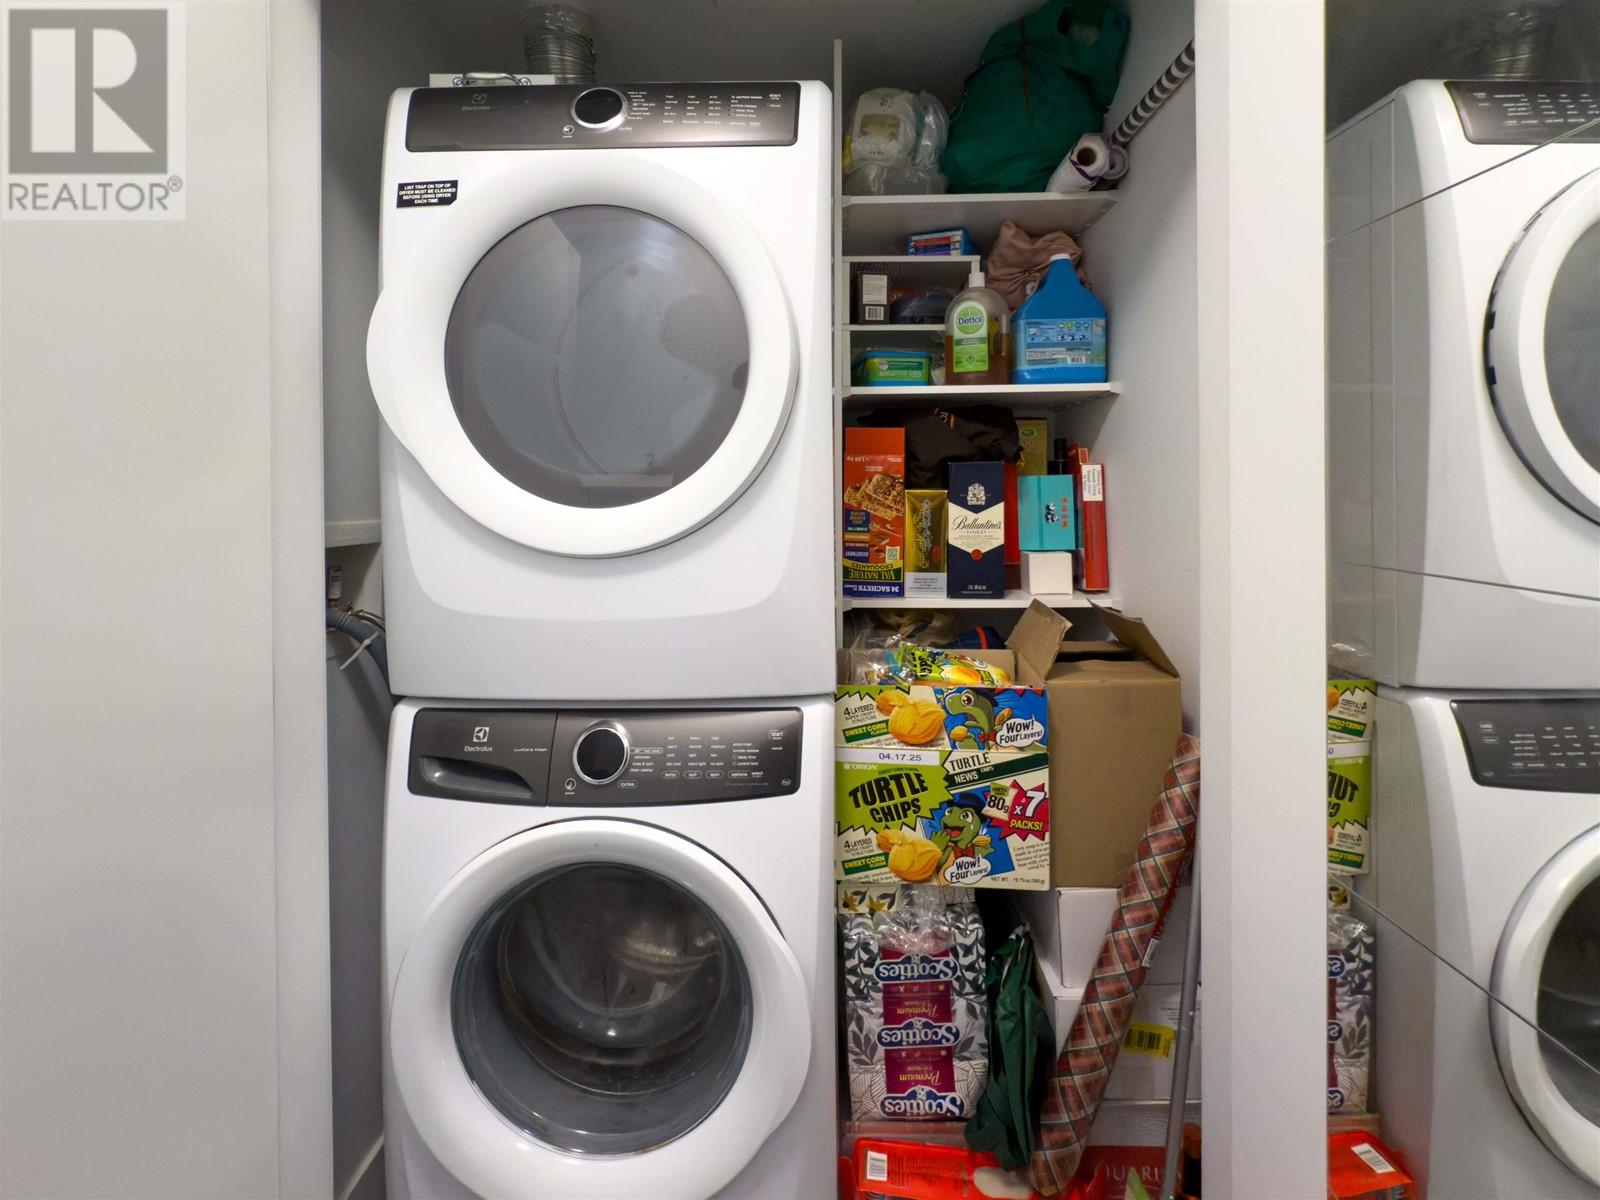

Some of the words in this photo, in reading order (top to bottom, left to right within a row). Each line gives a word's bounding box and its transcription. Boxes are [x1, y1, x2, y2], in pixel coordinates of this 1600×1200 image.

[959, 316, 982, 325] Dettol
[952, 515, 1002, 531] Ballantine's
[849, 569, 879, 580] NATURE
[881, 570, 896, 580] VAL
[843, 707, 851, 716] 4
[851, 703, 875, 715] LAYERED
[845, 726, 867, 736] SWEET
[867, 722, 887, 731] CORN
[1006, 720, 1035, 734] Wow!
[1000, 733, 1020, 744] Four
[1020, 729, 1043, 740] Layers!
[879, 752, 922, 762] 04.17.25
[949, 752, 991, 772] TURTLE
[954, 771, 979, 785] NEWS
[848, 772, 929, 809] TURTLE
[869, 797, 921, 823] CHIPS
[987, 794, 1010, 814] 80g
[1009, 818, 1044, 831] PACKS!
[844, 840, 851, 849] 4
[851, 838, 873, 848] LAYERED
[955, 856, 981, 870] Wow!
[950, 870, 970, 881] Four
[880, 960, 955, 980] Scotties
[897, 1005, 938, 1017] Premium
[881, 1024, 957, 1046] Scotties
[899, 1070, 942, 1085] Premium
[884, 1095, 961, 1116] Scotties
